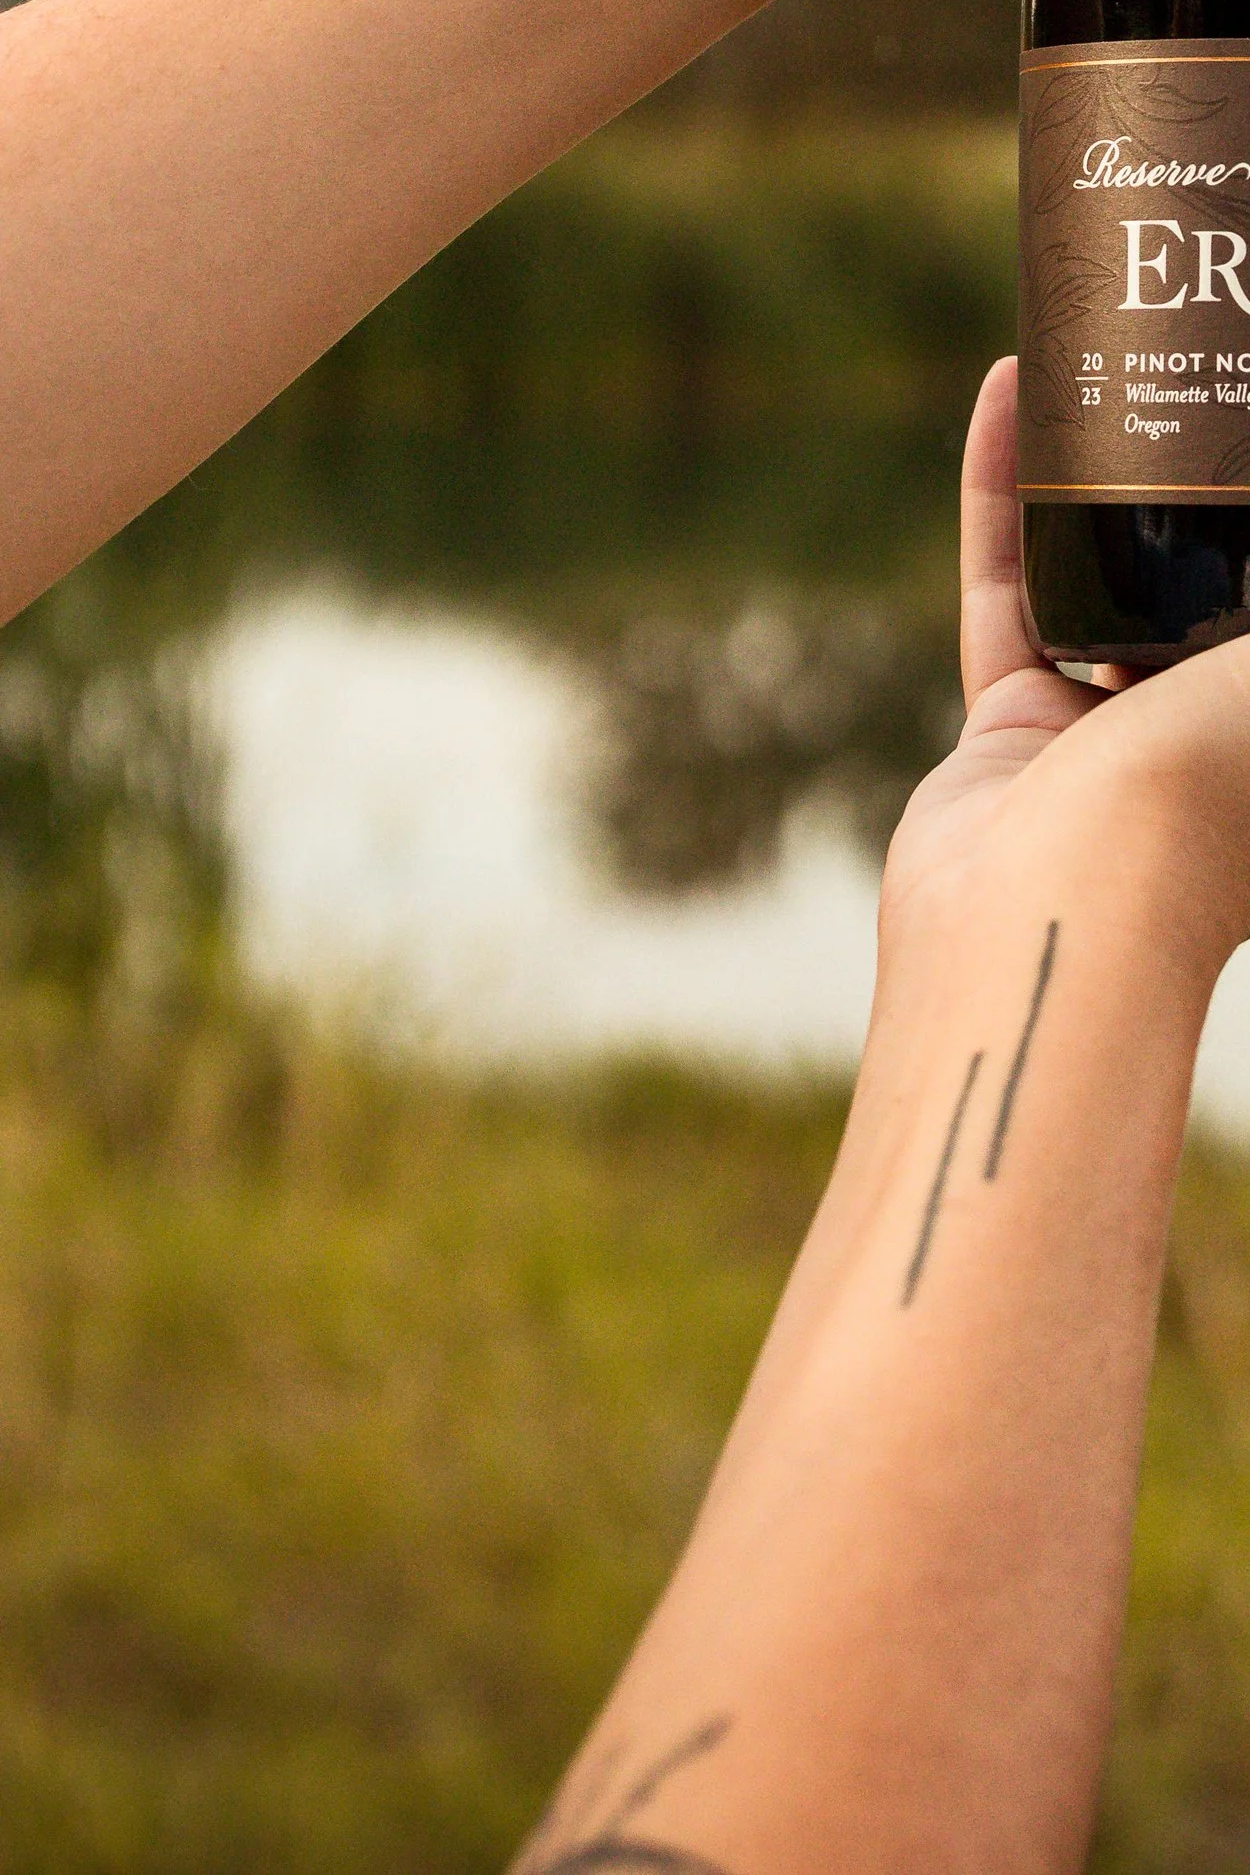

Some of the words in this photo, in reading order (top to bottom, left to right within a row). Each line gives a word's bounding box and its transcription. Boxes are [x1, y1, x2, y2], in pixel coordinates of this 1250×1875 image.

[1081, 352, 1103, 371] 20
[1124, 352, 1205, 373] PINOT
[1081, 387, 1101, 406] 23
[1124, 382, 1210, 403] Willamette
[1124, 413, 1181, 441] Oregon
